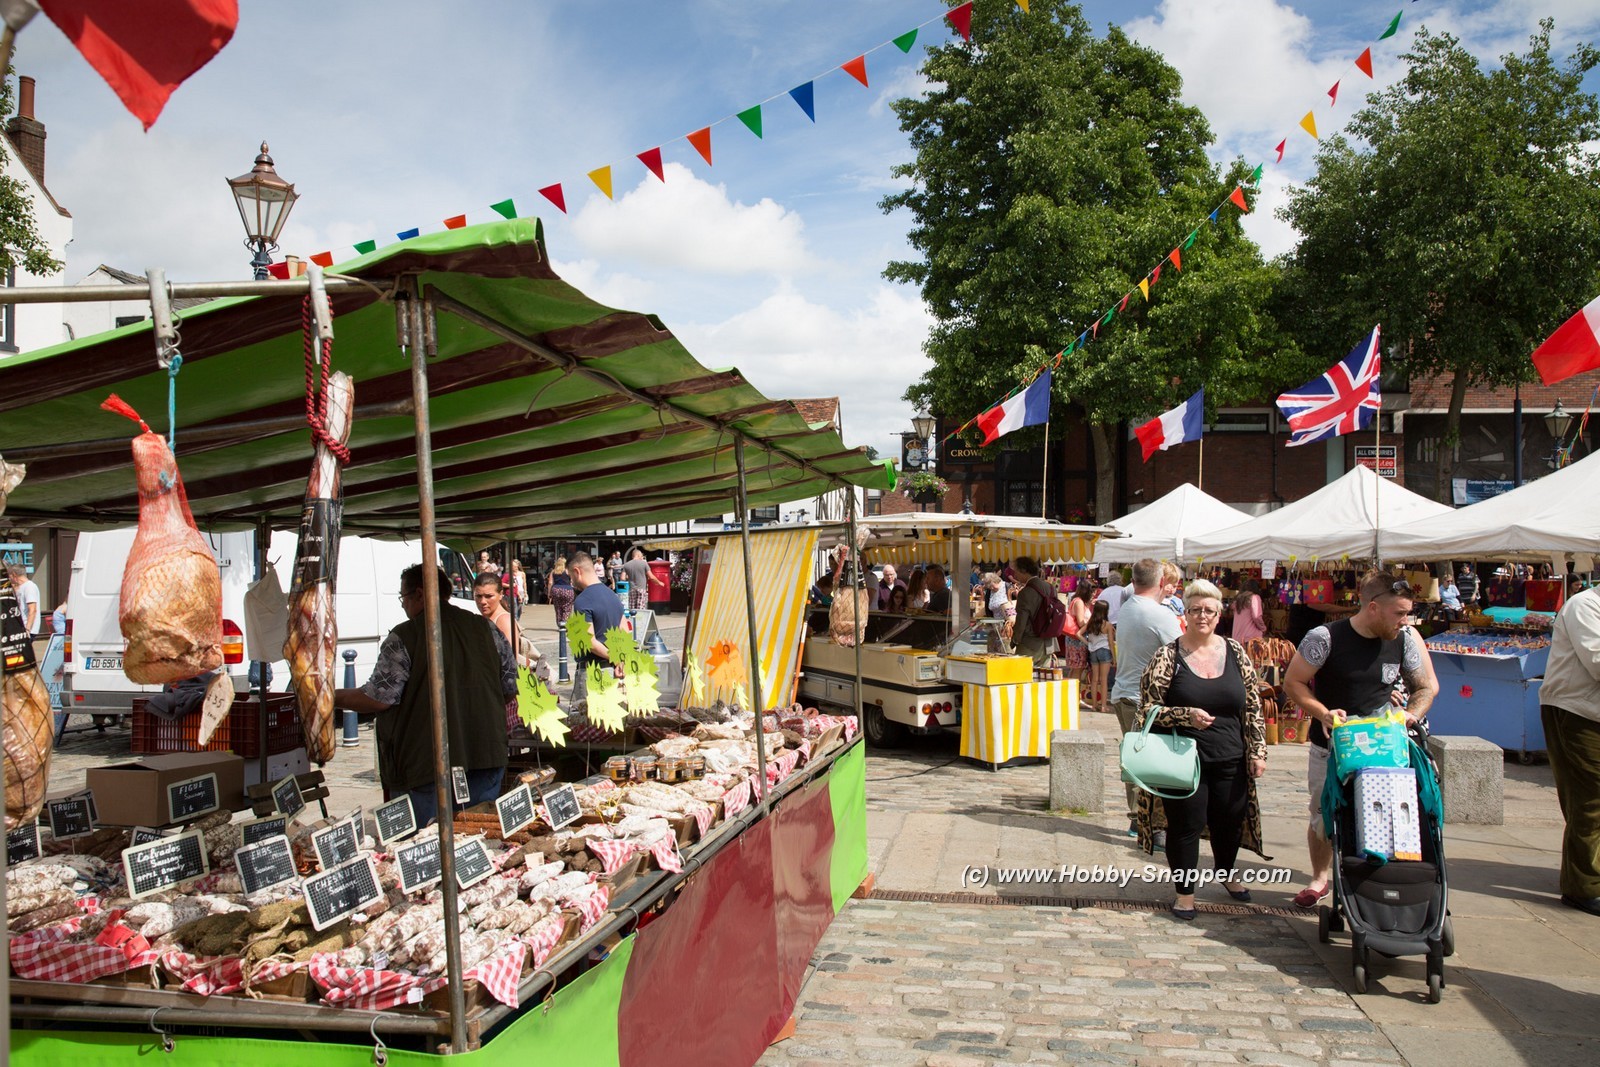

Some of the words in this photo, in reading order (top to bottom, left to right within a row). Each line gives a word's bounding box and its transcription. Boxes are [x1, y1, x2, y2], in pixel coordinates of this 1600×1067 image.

[956, 431, 980, 440] RE
[179, 780, 204, 795] FIGUE
[137, 844, 181, 863] Calvados
[314, 865, 357, 892] CHESNUT
